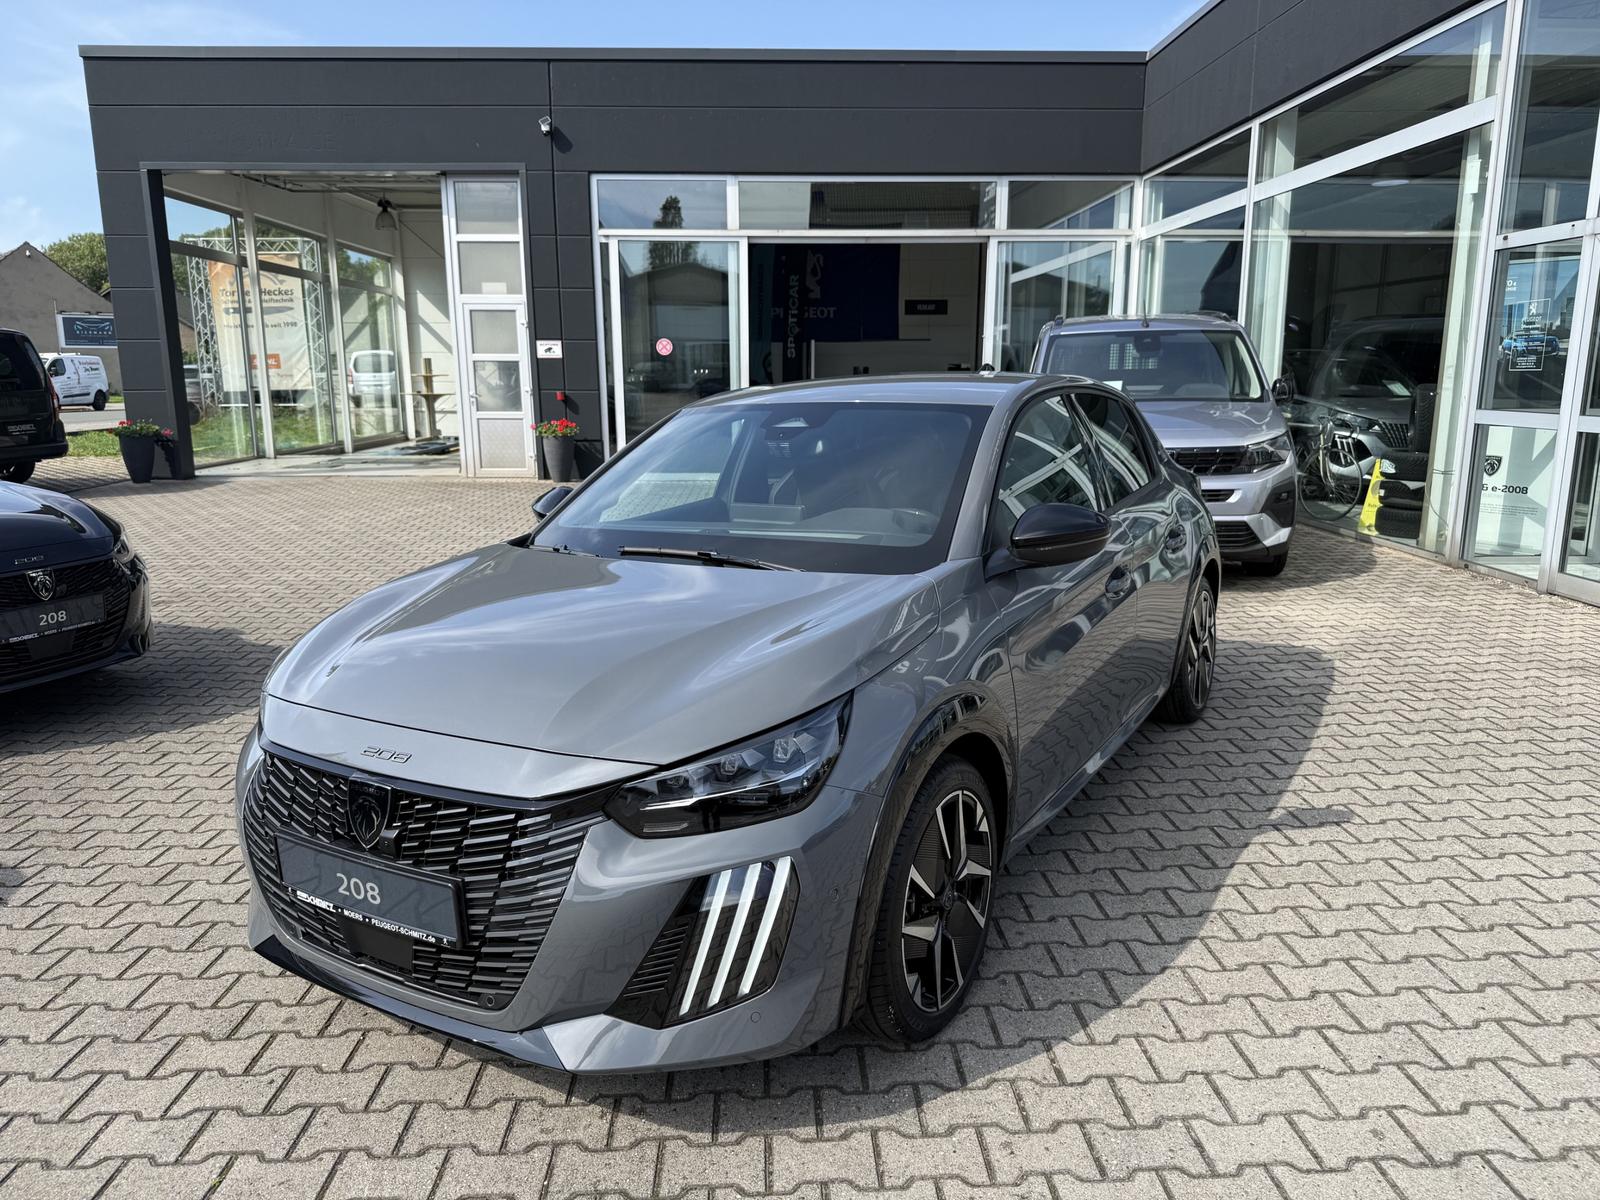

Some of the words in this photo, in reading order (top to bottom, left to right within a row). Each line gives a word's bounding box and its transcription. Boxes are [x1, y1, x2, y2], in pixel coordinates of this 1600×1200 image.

[260, 287, 294, 297] Heckes
[770, 306, 837, 319] PEOT
[787, 275, 799, 358] SPOTICAR
[1491, 485, 1529, 495] e-2008
[39, 610, 67, 626] 208
[361, 746, 413, 764] 208
[336, 872, 381, 905] 208
[343, 908, 363, 922] MOERS
[371, 918, 436, 944] PEUGEOT-SCHMITZ.de
